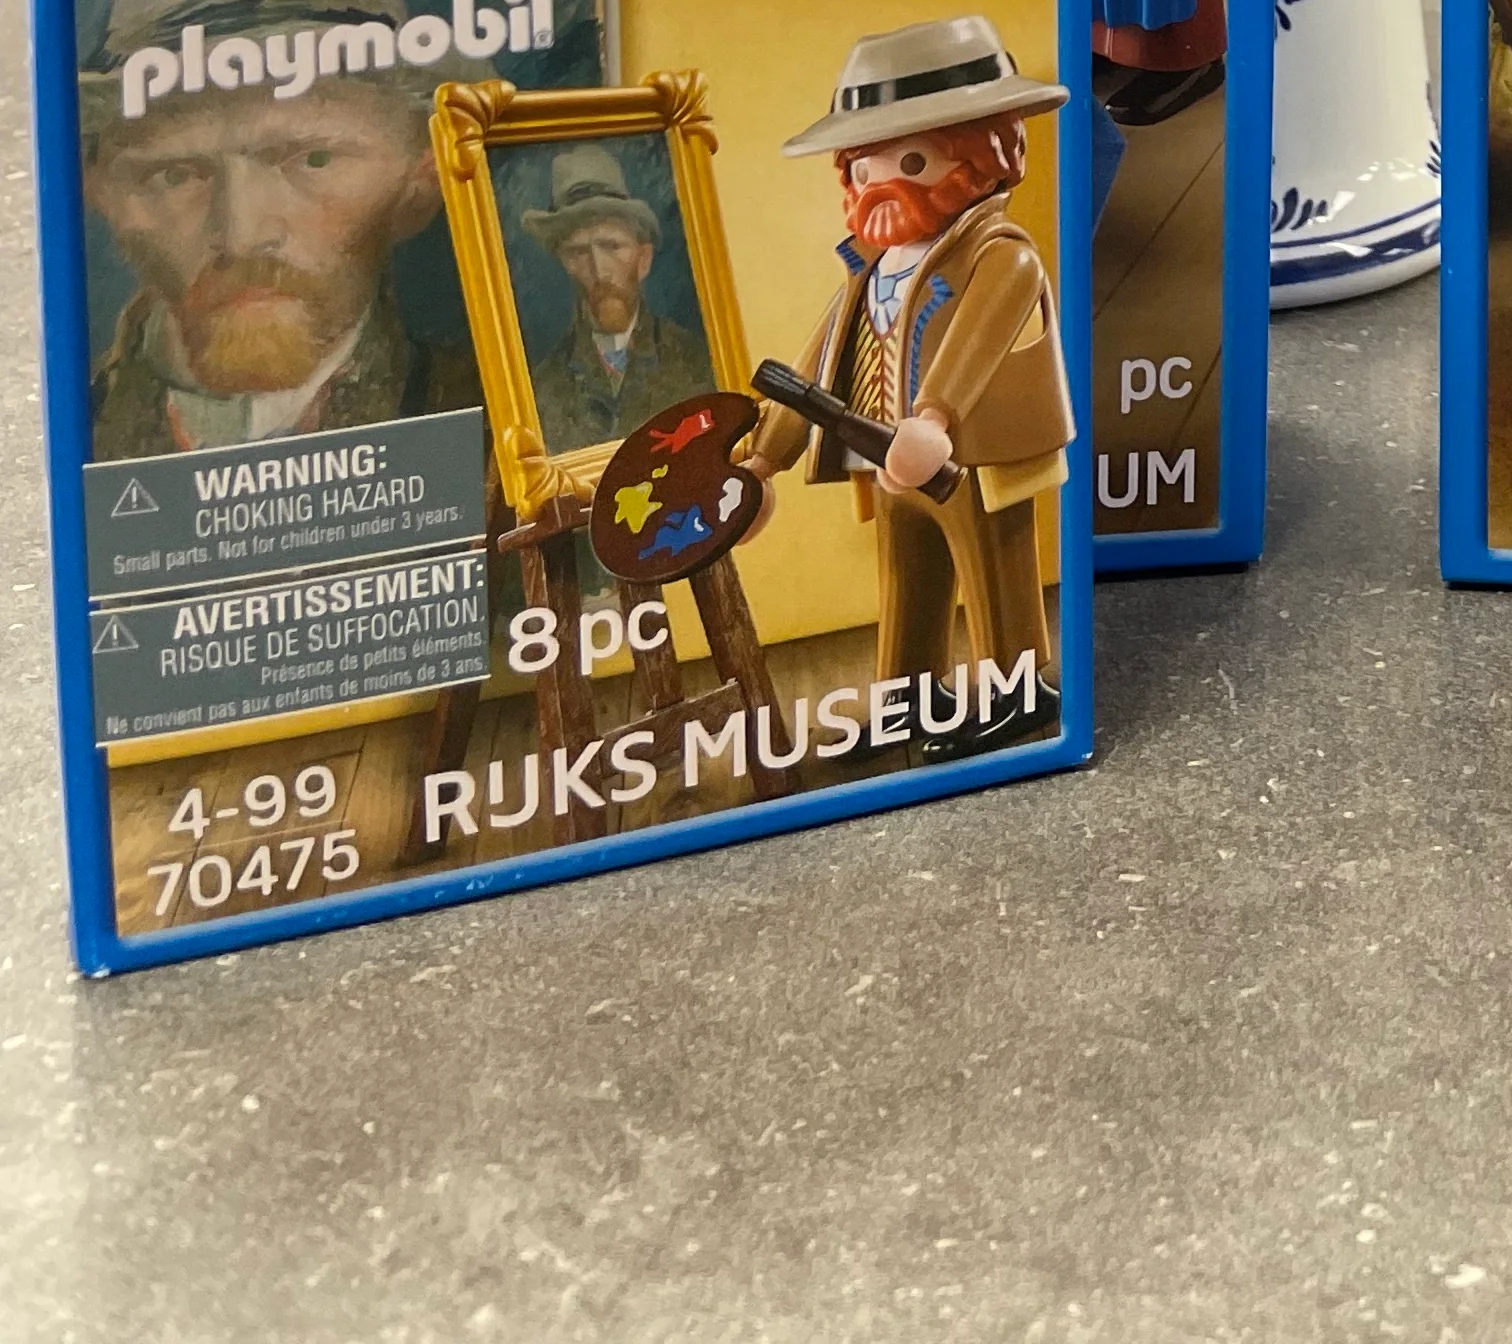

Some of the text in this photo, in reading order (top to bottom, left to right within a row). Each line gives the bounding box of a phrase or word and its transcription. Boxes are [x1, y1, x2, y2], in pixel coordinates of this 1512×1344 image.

[1121, 355, 1193, 414] pc
[194, 441, 387, 502] WARNING:
[195, 474, 424, 538] CHOKING HAZARD
[113, 549, 160, 575] Small
[218, 537, 247, 560] Not
[252, 532, 274, 554] for
[280, 521, 344, 550] children
[350, 513, 395, 538] under
[401, 510, 410, 529] 3
[171, 556, 484, 640] AVERTISSEMENT:
[159, 594, 485, 678] RISQUE DE SUFFOCATION.
[260, 655, 333, 685] Présence
[339, 651, 357, 671] de
[363, 643, 406, 670] petits
[507, 601, 668, 676] 8 pc
[106, 714, 128, 734] Ne
[133, 702, 201, 732] convient
[208, 699, 236, 722] pas
[241, 694, 269, 713] aux
[274, 679, 333, 708] enfants
[339, 675, 358, 696] de
[364, 666, 412, 691] moins
[417, 662, 436, 682] de
[441, 658, 450, 676] 3
[424, 648, 1038, 843] RIJKS MUSEUM
[168, 764, 337, 840] 4-99
[147, 828, 361, 916] 70475
